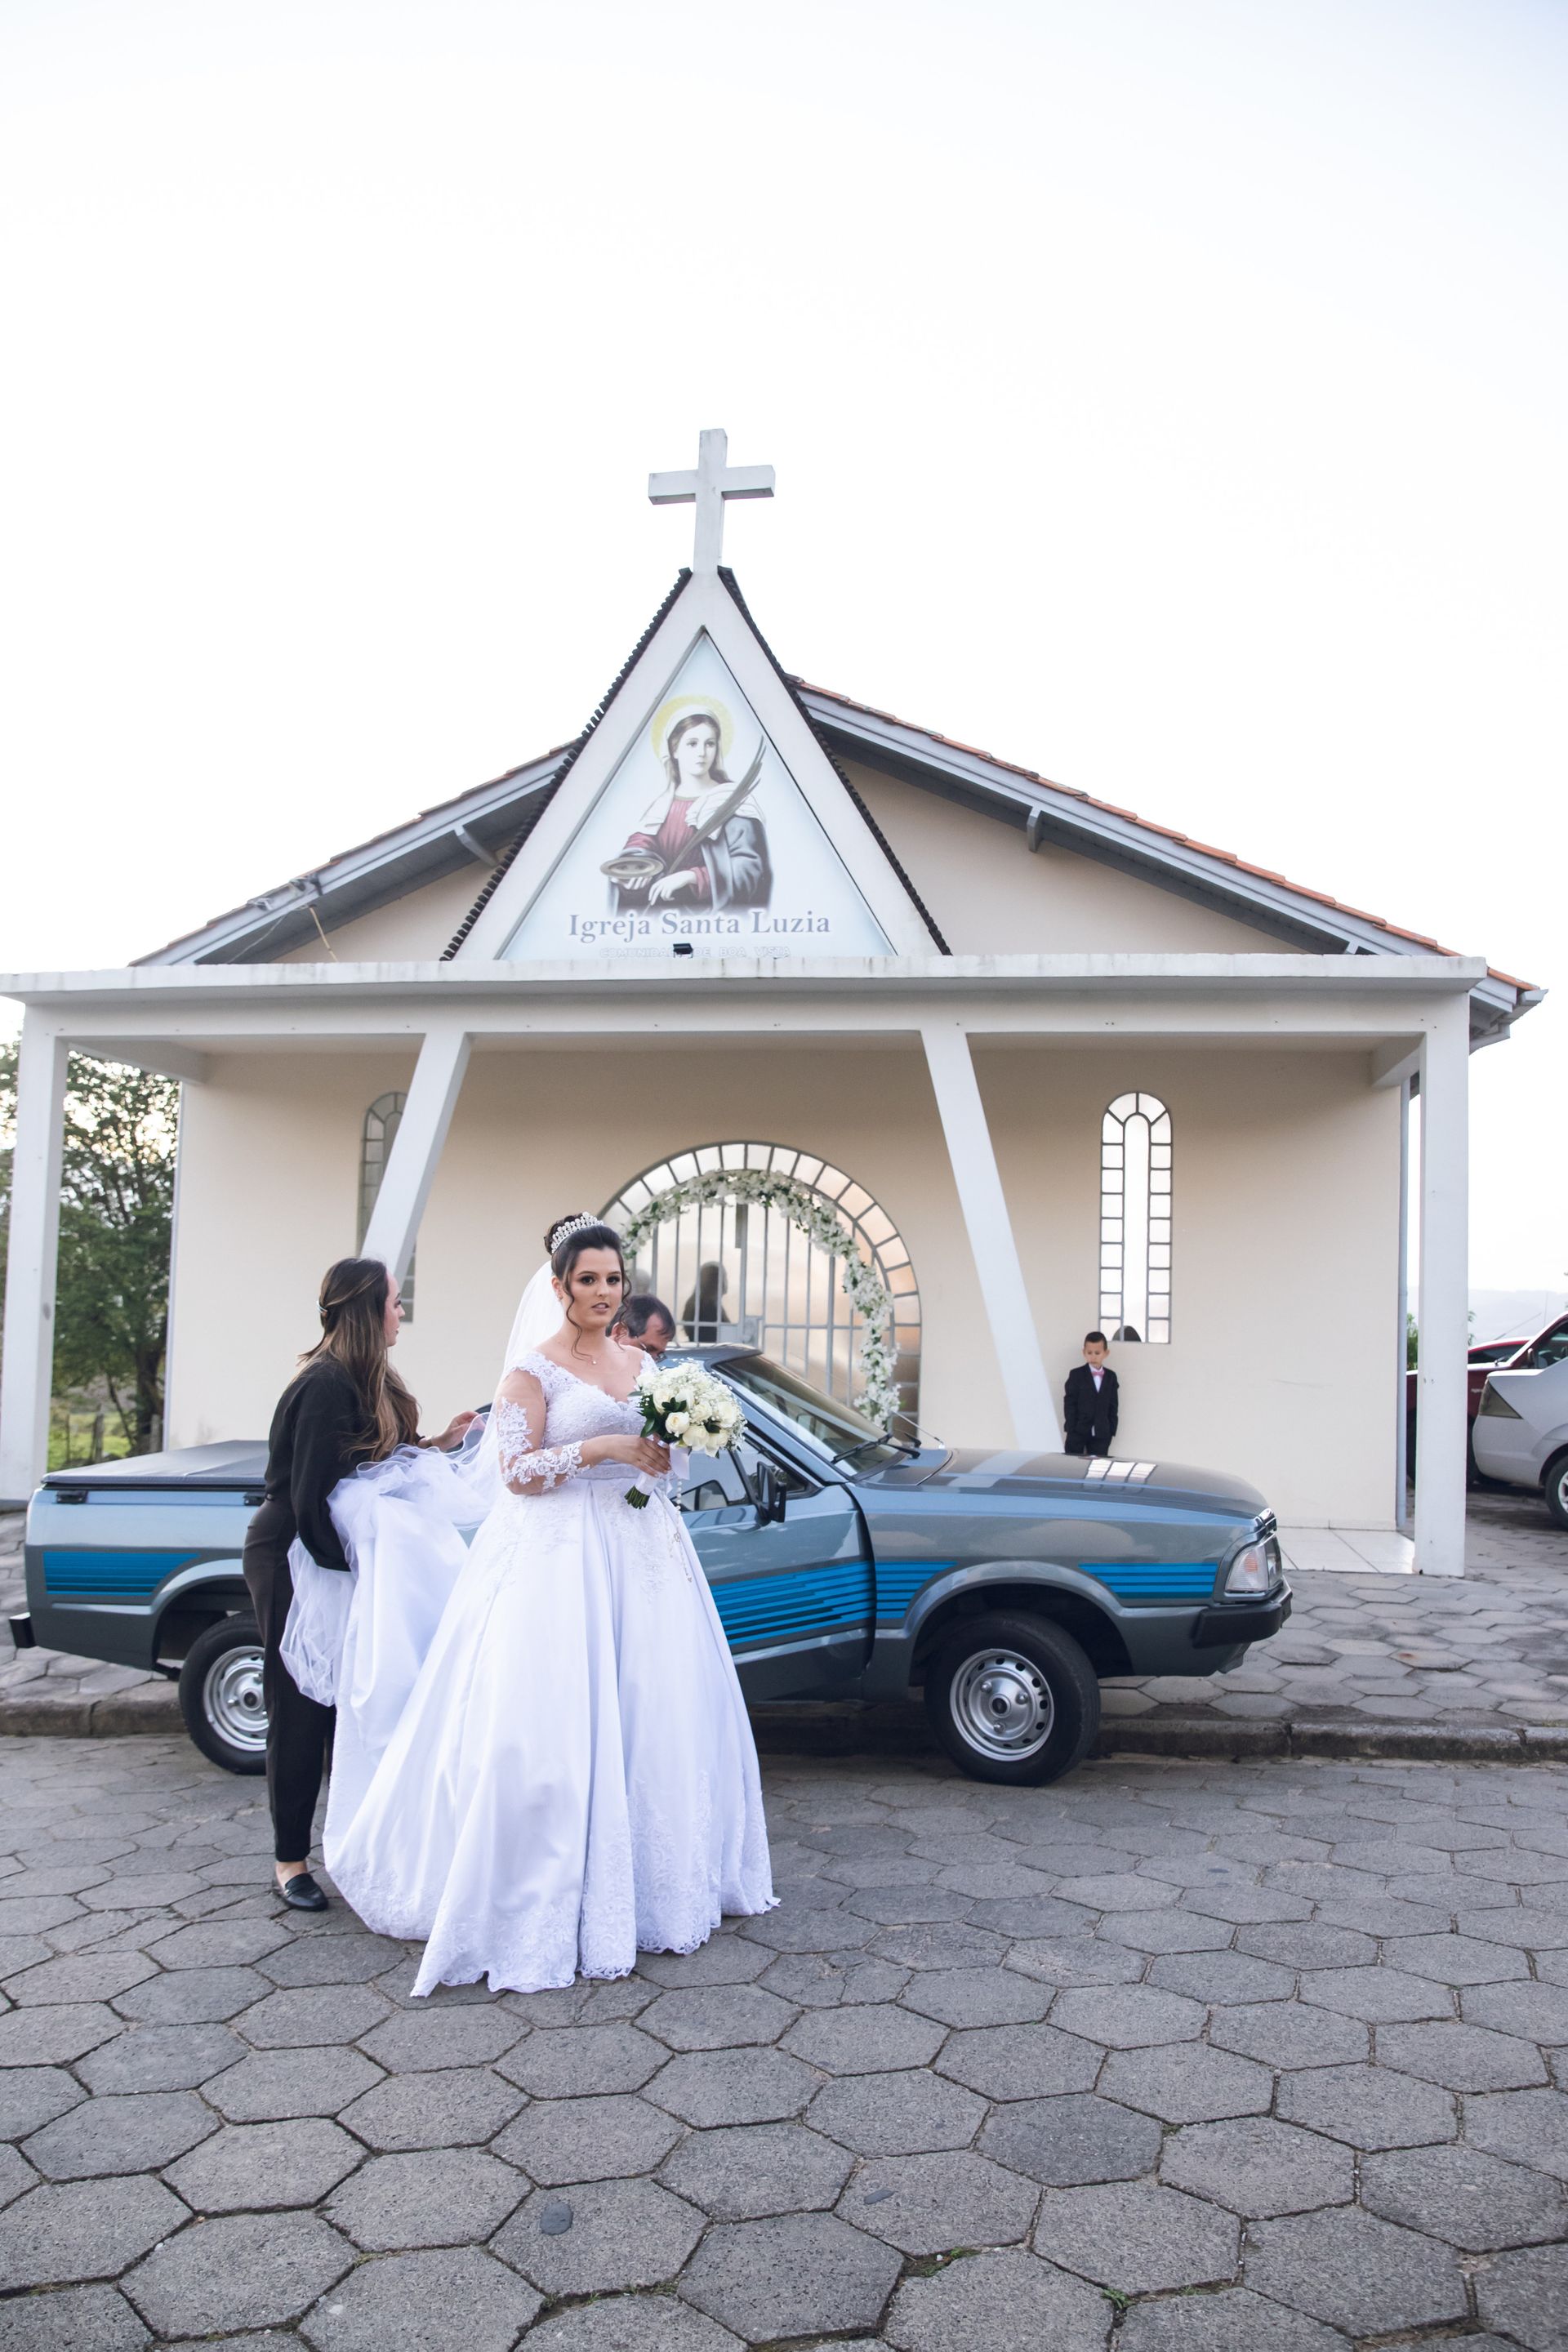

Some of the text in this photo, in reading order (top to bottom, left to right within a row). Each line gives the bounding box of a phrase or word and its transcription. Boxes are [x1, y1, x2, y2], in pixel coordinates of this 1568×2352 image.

[568, 911, 831, 944] Igreja Santa Luzia
[599, 947, 684, 958] COMUNIDAD
[719, 947, 746, 958] BOA
[754, 946, 791, 958] VISTA
